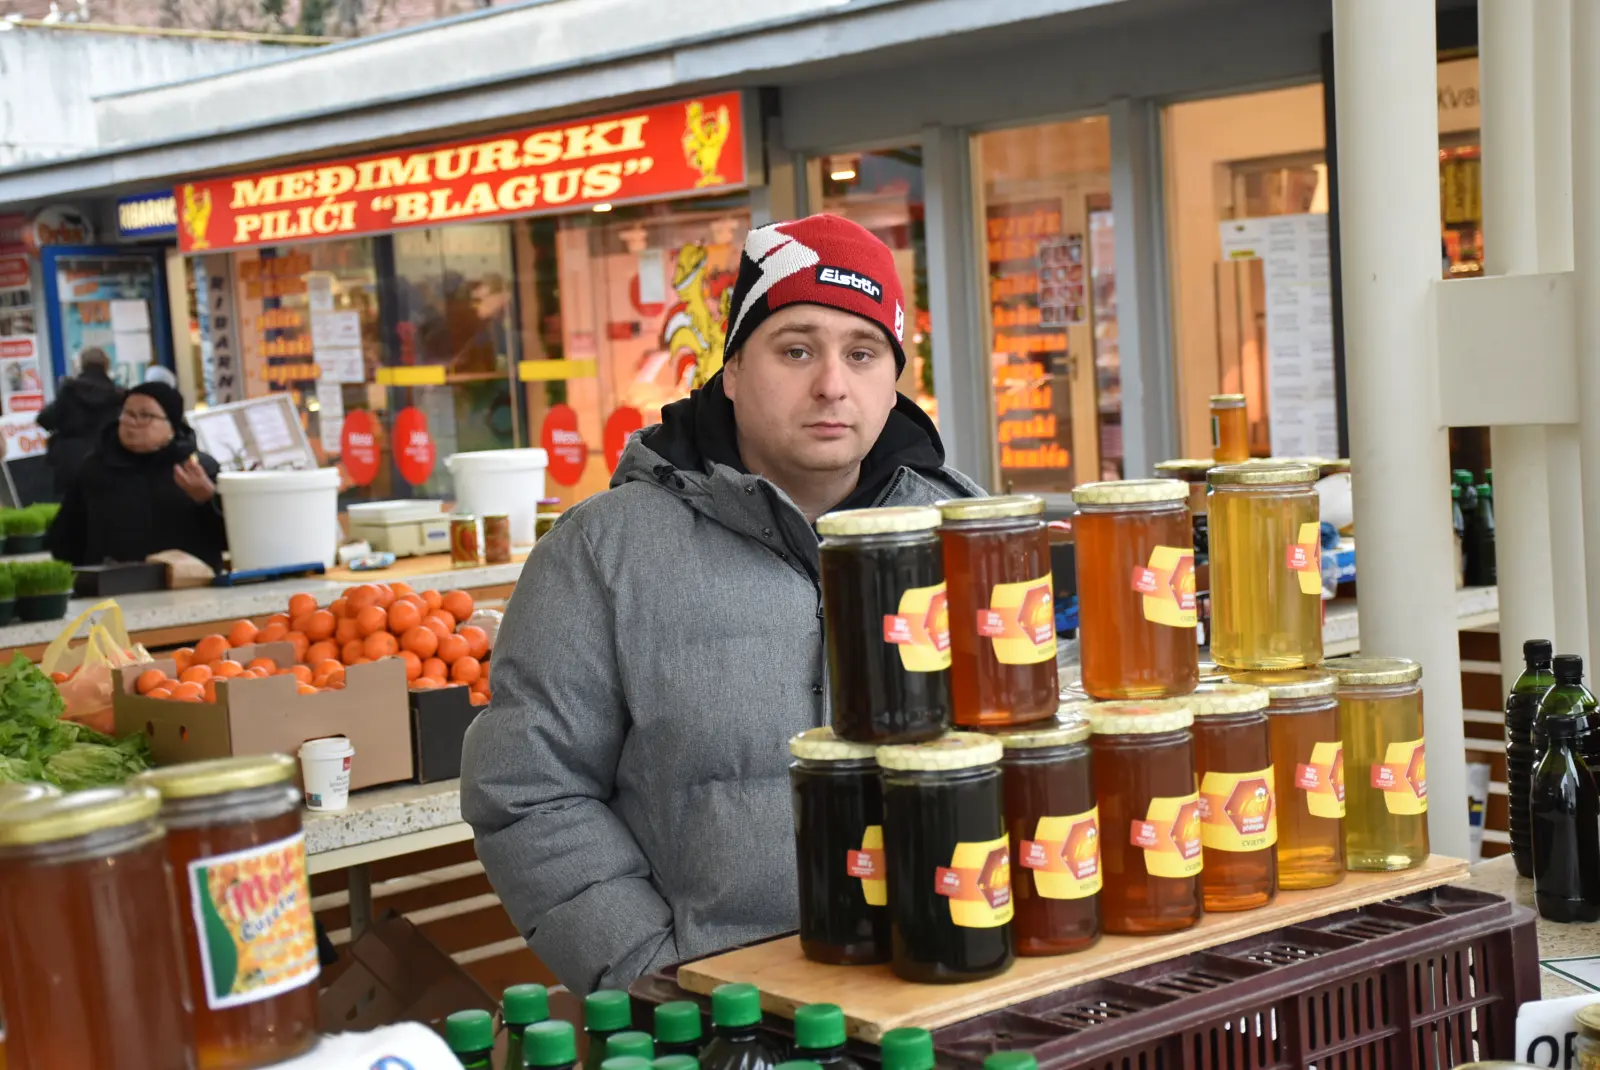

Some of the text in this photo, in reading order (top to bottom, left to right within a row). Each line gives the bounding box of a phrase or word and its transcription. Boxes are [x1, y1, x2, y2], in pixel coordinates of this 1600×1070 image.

[230, 115, 649, 210] MEĐIMURSKI
[235, 195, 355, 243] PILIĆI
[819, 267, 880, 297] Eisbär
